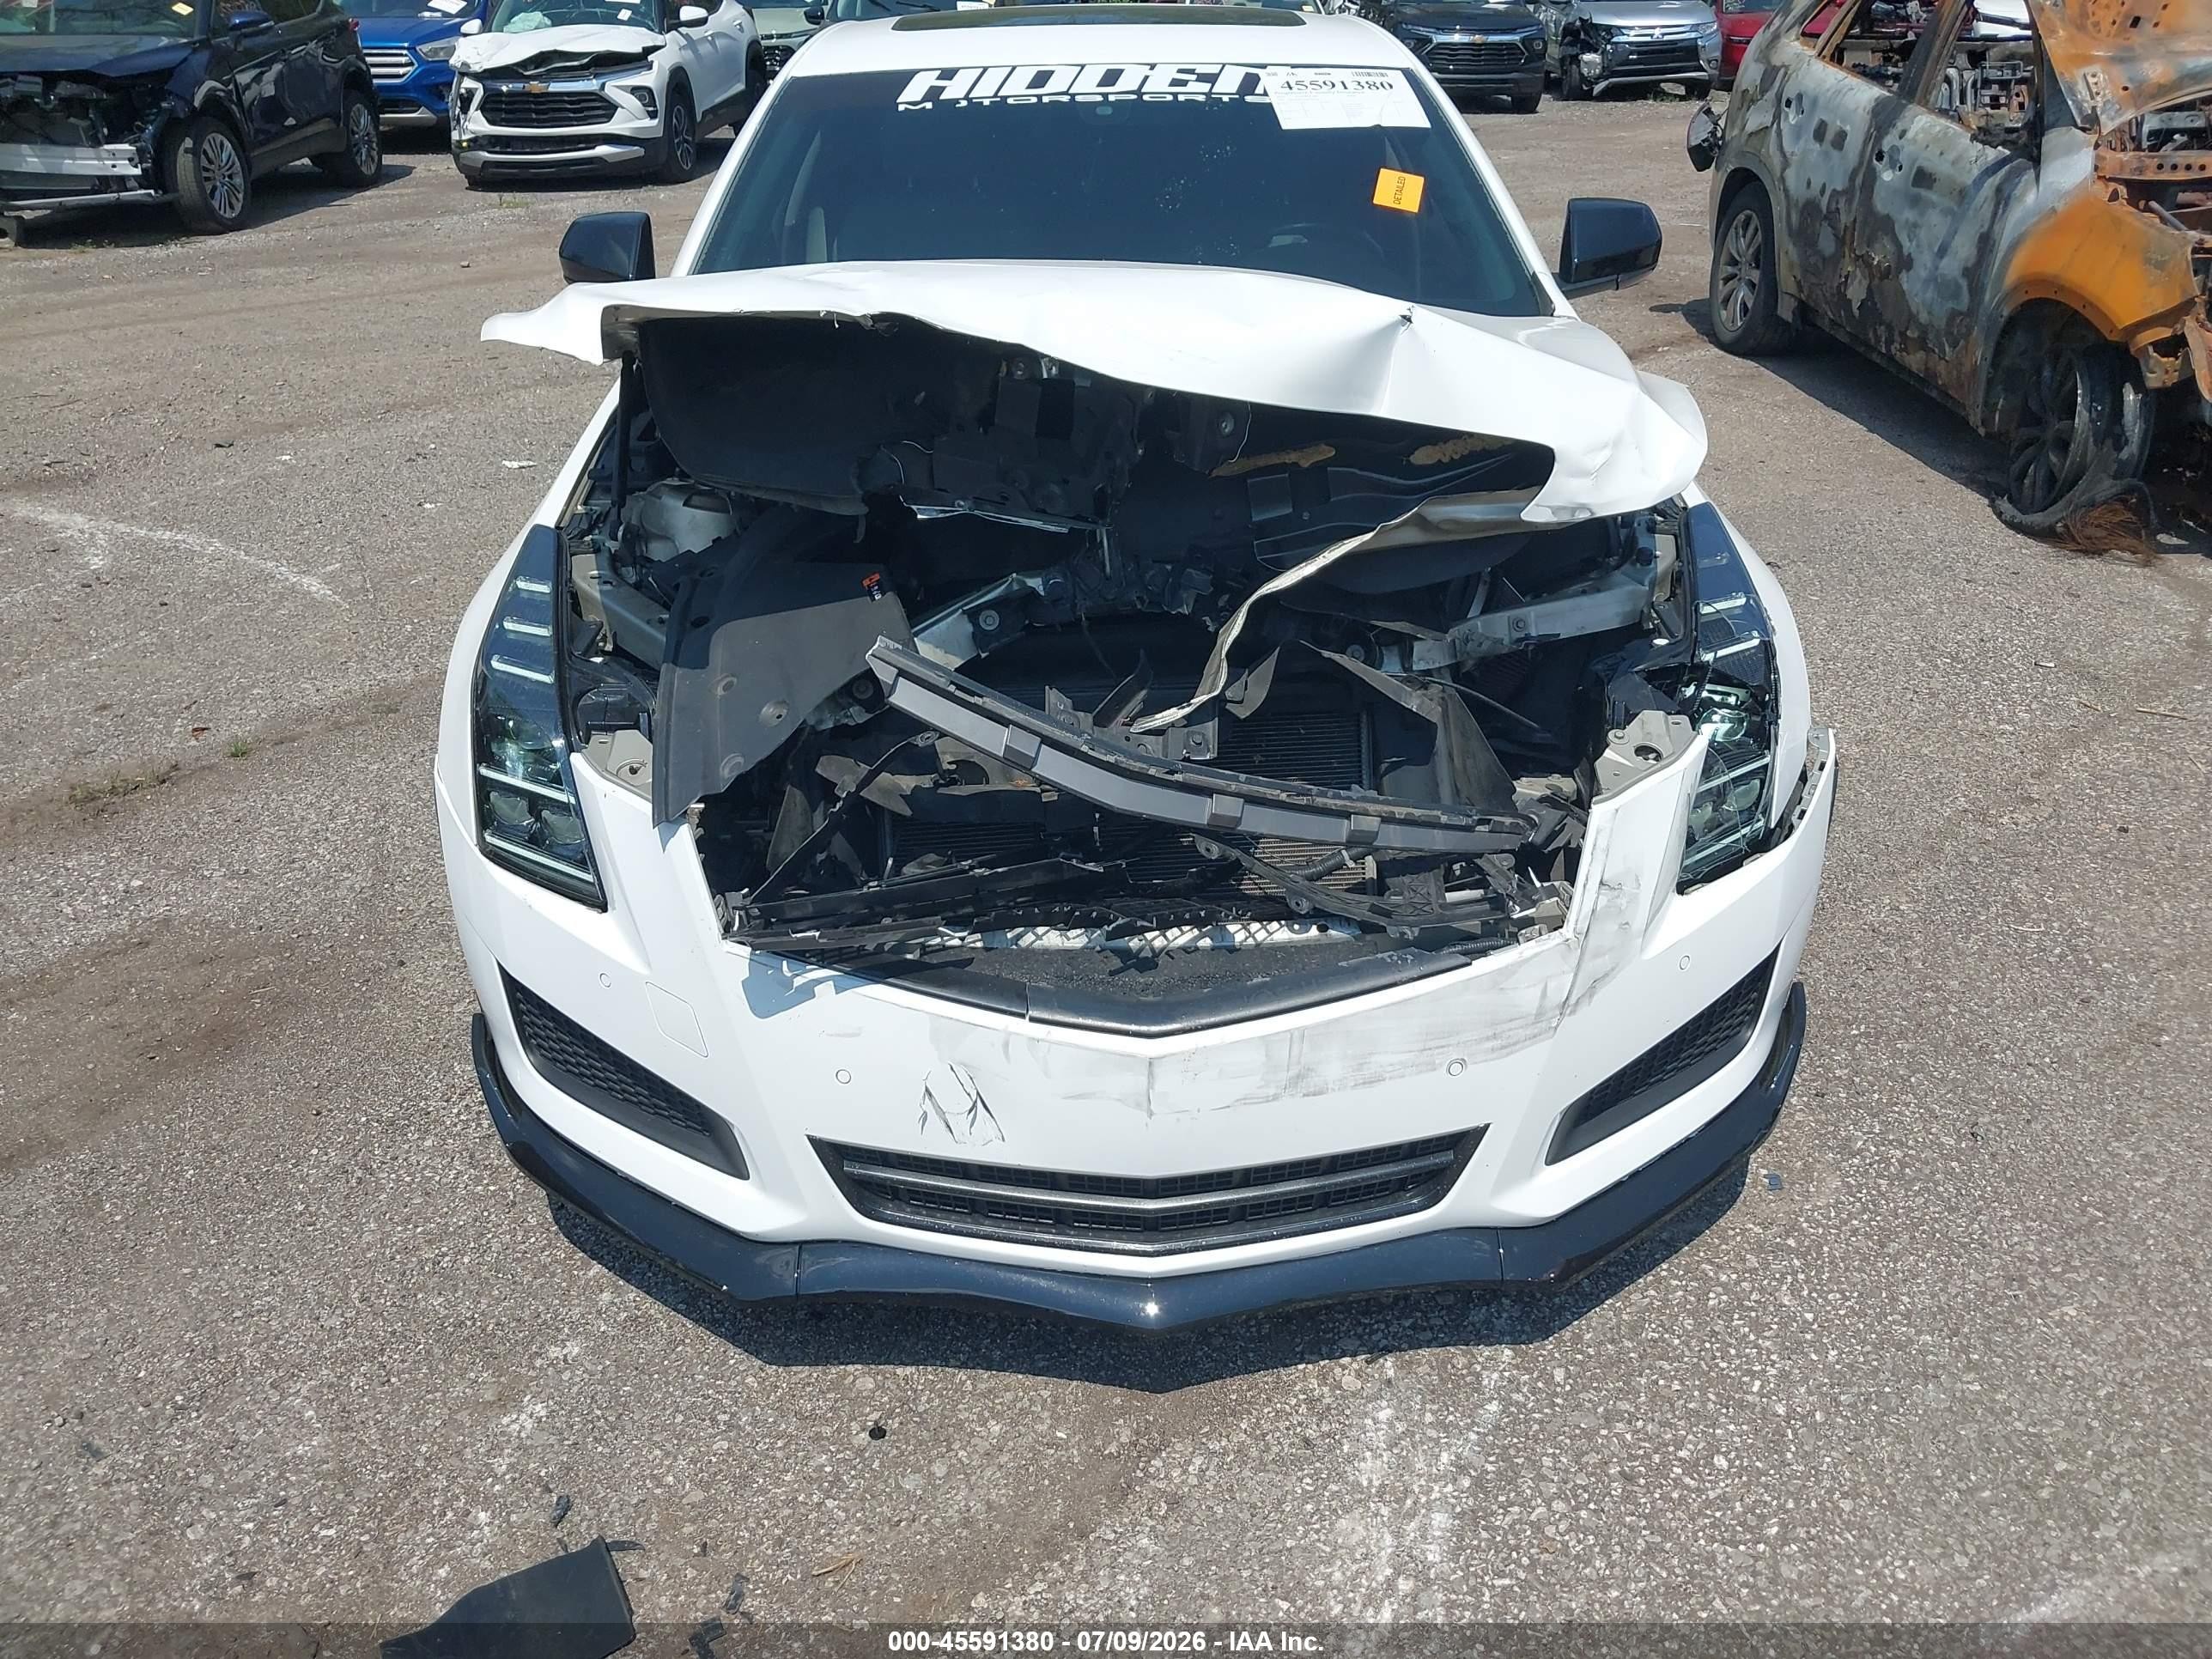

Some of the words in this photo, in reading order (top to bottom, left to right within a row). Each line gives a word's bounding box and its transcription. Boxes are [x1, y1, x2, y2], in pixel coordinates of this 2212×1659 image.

[896, 64, 1266, 103] HIDDEN
[1280, 80, 1394, 91] 45591380
[1393, 176, 1406, 205] DETAILED
